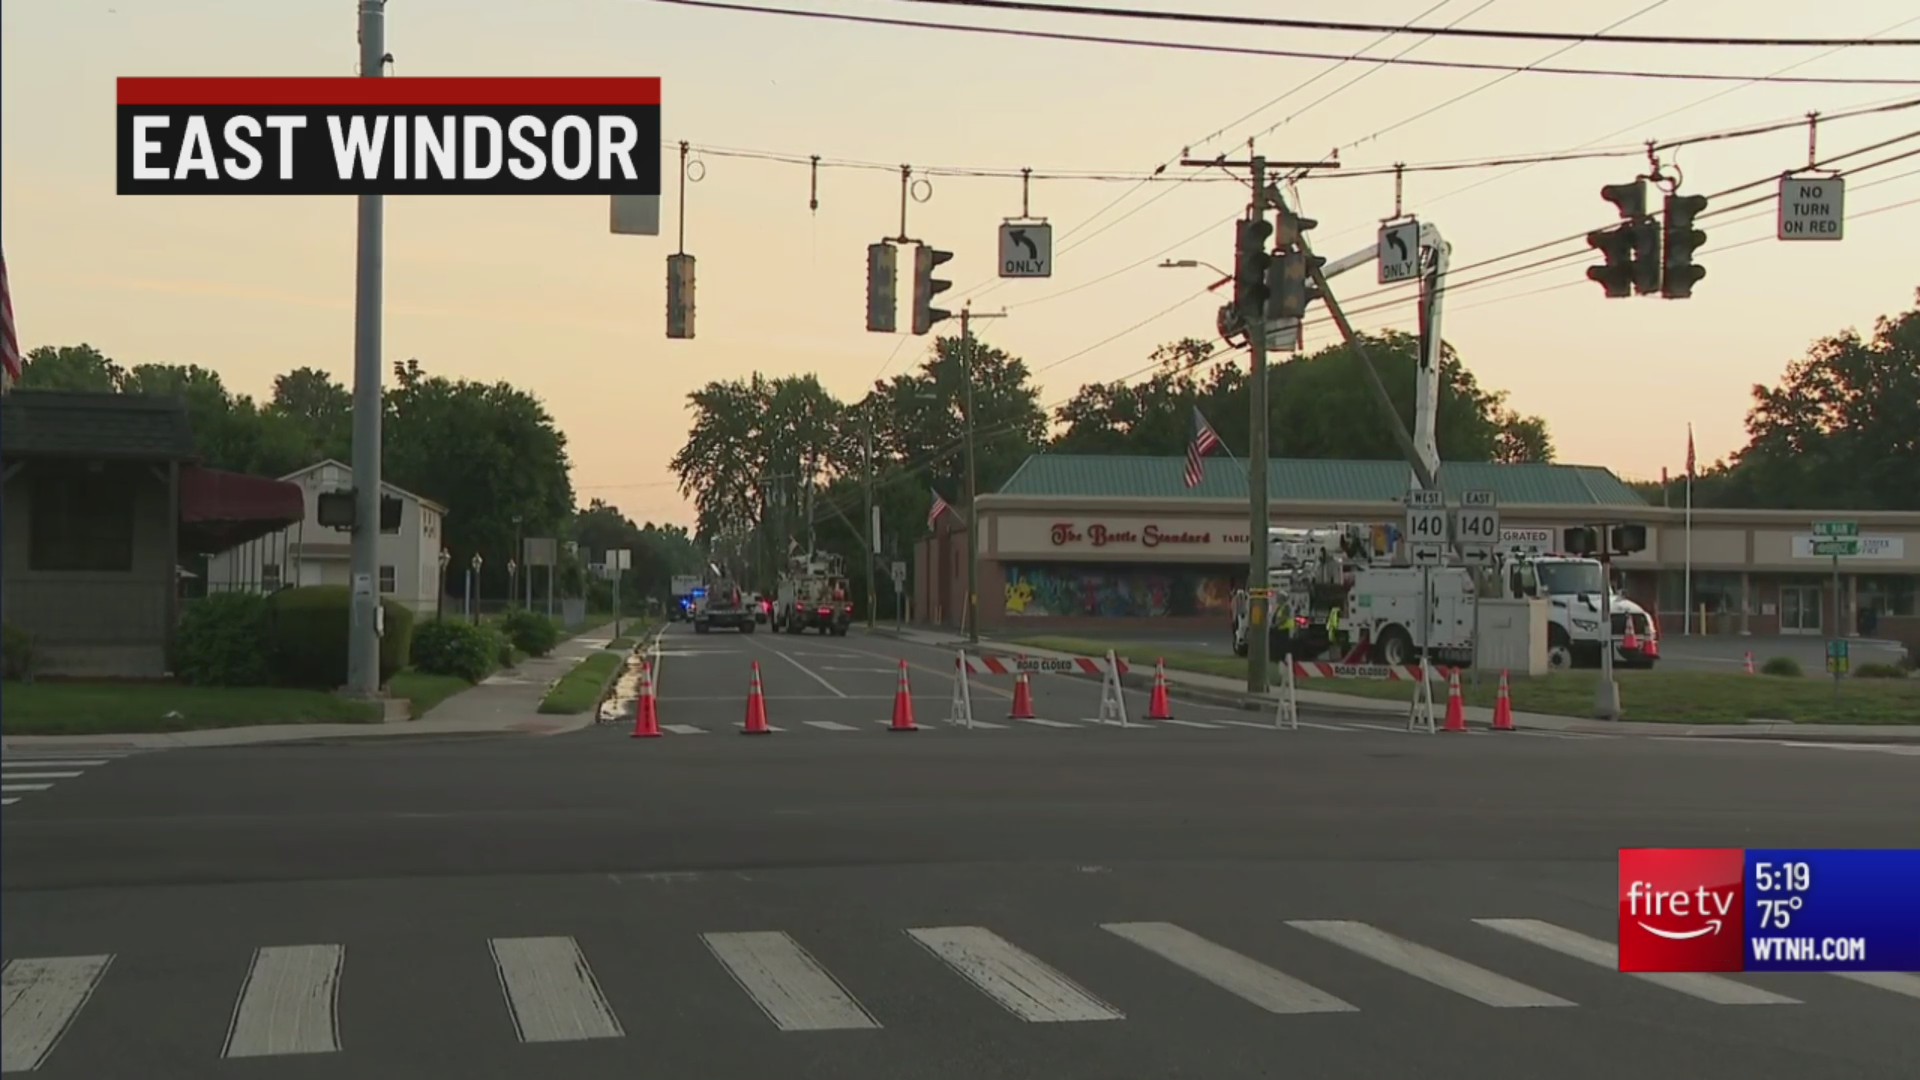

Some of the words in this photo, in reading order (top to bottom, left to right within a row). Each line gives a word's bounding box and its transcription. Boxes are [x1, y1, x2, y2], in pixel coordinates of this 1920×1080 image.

[1800, 185, 1823, 199] NO
[1793, 203, 1830, 216] TURN
[1784, 220, 1804, 233] ON
[1810, 220, 1838, 233] RED
[1005, 260, 1044, 273] ONLY
[1383, 261, 1413, 279] ONLY
[1414, 492, 1439, 504] WEST
[1466, 492, 1491, 504] EAST
[1411, 516, 1443, 536] 140
[1461, 516, 1495, 536] 140
[1051, 523, 1083, 546] The
[1087, 524, 1137, 547] Battle
[1142, 525, 1211, 548] Standard
[1016, 660, 1039, 671] ROAD
[1041, 660, 1073, 671] CLOSED
[1335, 666, 1357, 676] ROAD
[1358, 666, 1390, 677] CLOSED
